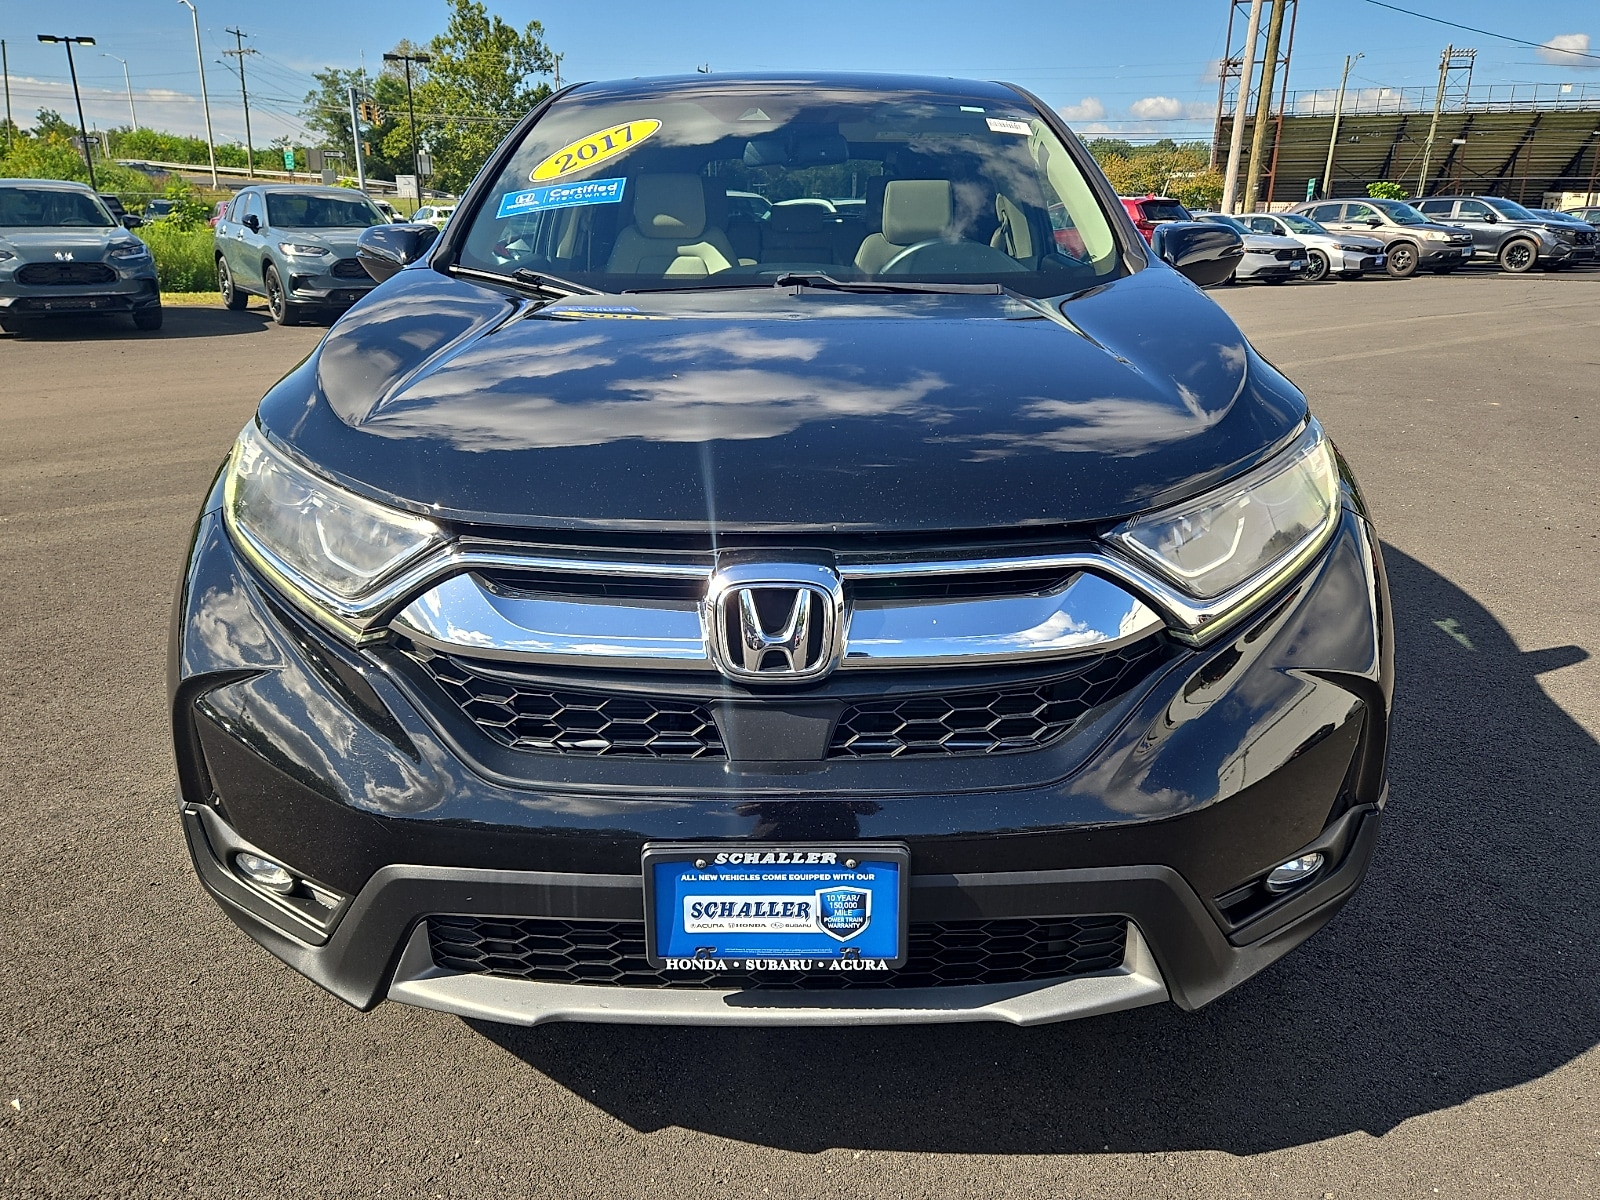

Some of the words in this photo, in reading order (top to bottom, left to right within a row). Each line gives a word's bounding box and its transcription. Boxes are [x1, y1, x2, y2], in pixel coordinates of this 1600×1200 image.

[553, 126, 632, 173] 2017
[549, 183, 618, 197] Certified
[714, 852, 838, 865] SCHALLER
[681, 874, 697, 882] ALL
[789, 874, 831, 882] EQUIPPED
[826, 894, 835, 902] 10
[836, 894, 861, 902] YEAR/
[690, 901, 812, 922] SCHALLER
[829, 901, 858, 910] 150,000
[834, 909, 853, 917] MILE
[665, 959, 728, 971] HONDA
[745, 959, 813, 971] SUBARU
[829, 959, 889, 971] ACURA
